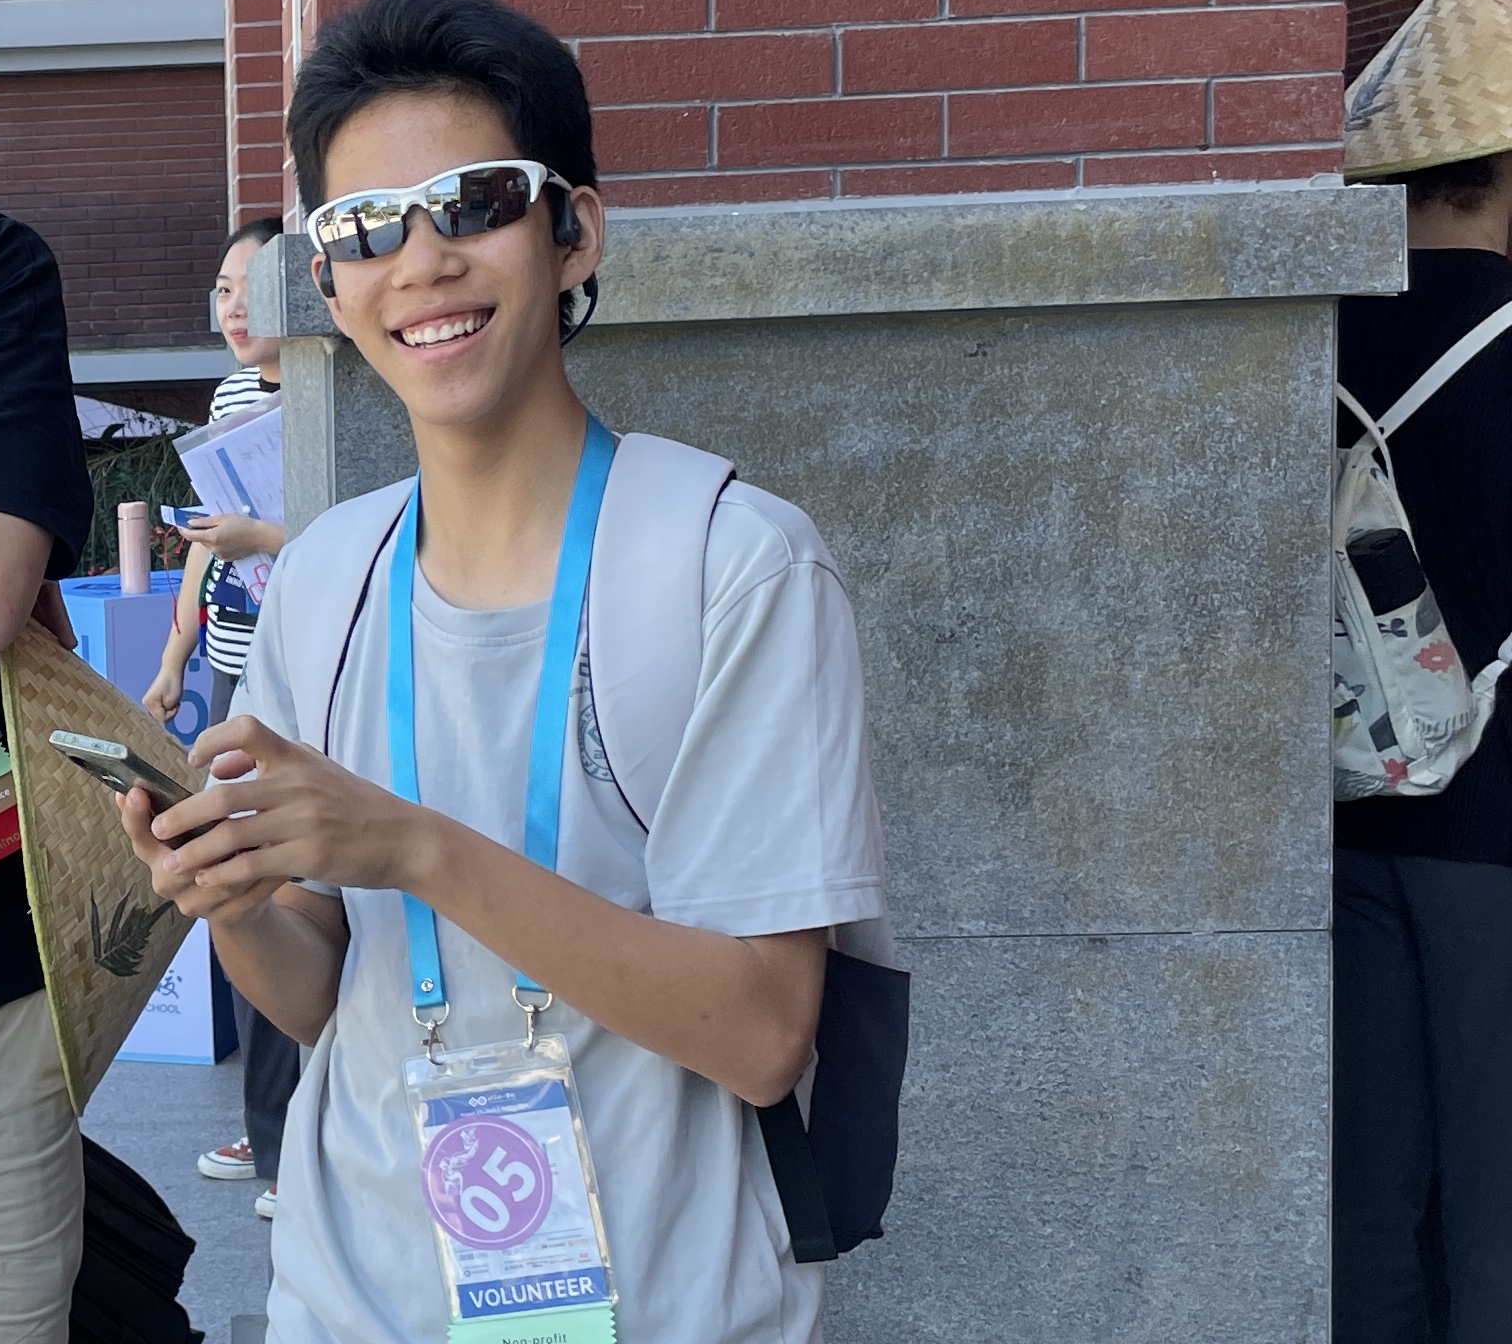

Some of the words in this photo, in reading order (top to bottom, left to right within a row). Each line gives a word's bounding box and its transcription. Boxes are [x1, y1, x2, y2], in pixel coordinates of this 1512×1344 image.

[146, 1003, 181, 1014] CHOOL
[460, 1146, 536, 1233] 05
[469, 1276, 594, 1308] VOLUNTEER
